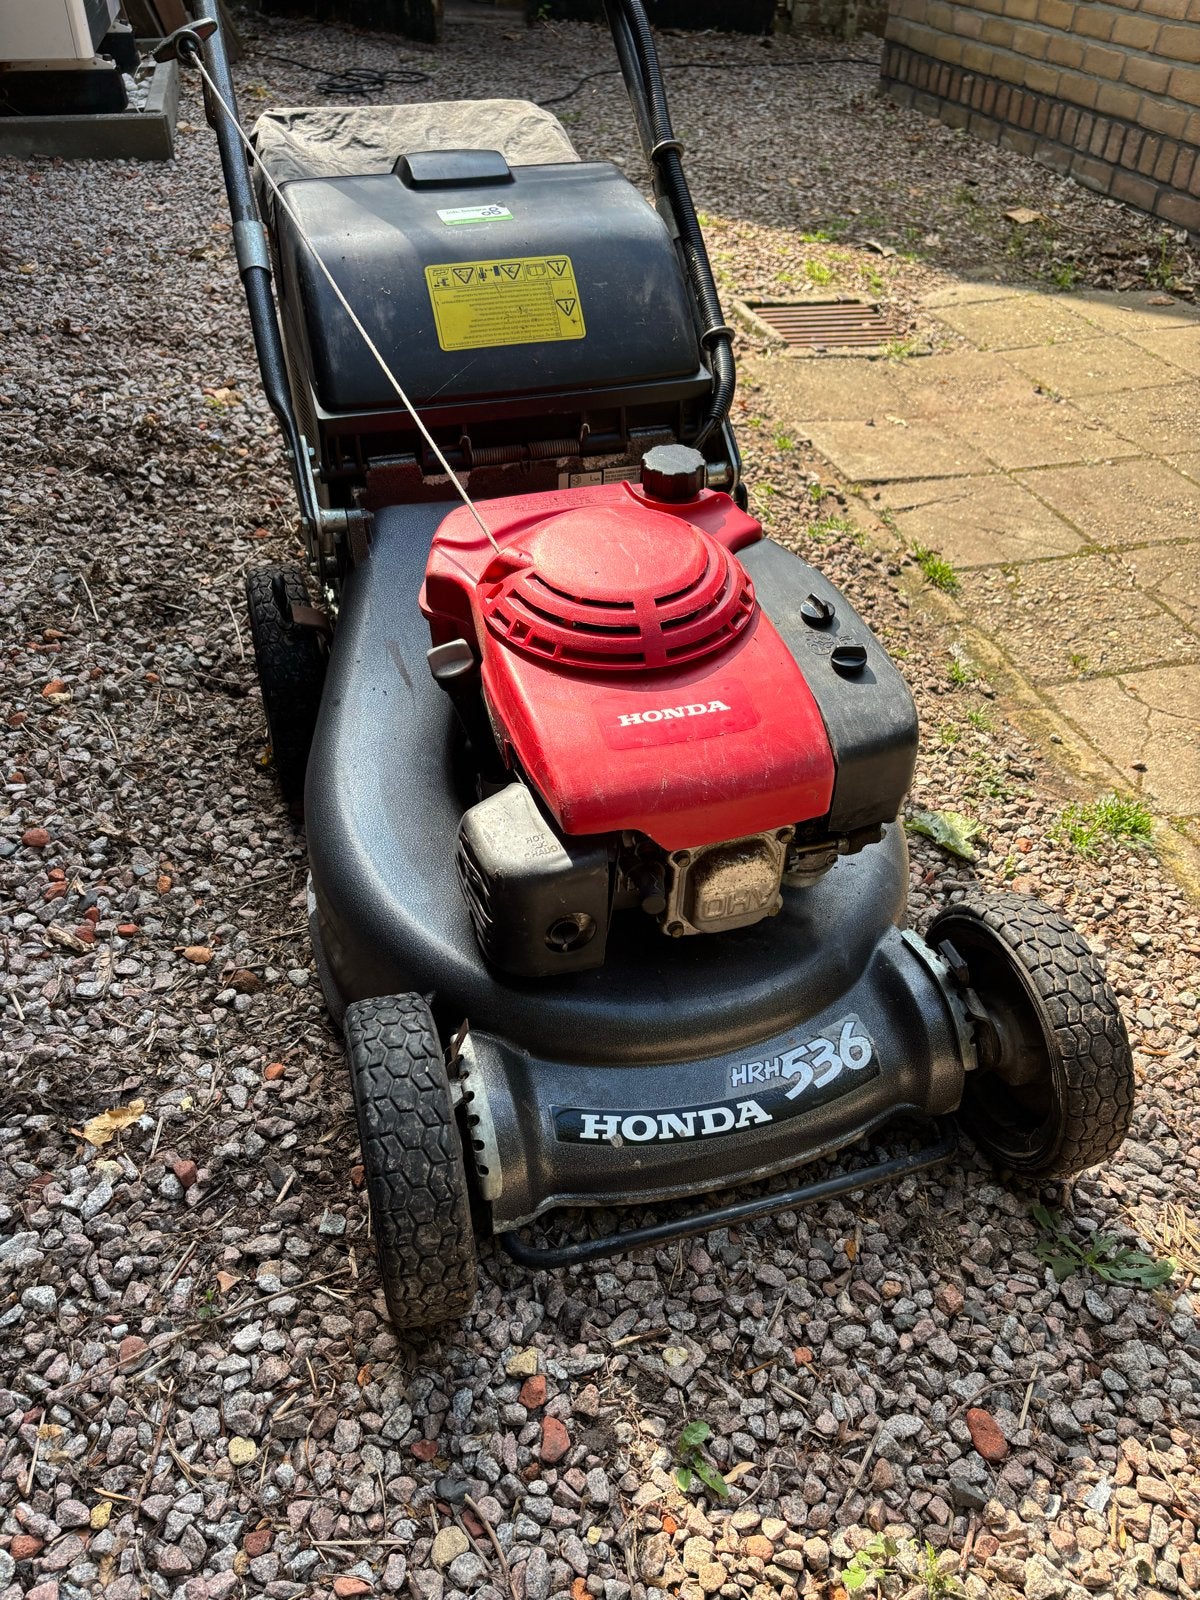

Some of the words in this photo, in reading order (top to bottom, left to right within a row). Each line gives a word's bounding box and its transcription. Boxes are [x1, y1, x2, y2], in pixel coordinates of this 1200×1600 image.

[618, 700, 731, 727] HONDA
[702, 882, 775, 919] OHV
[579, 1099, 773, 1142] HONDA
